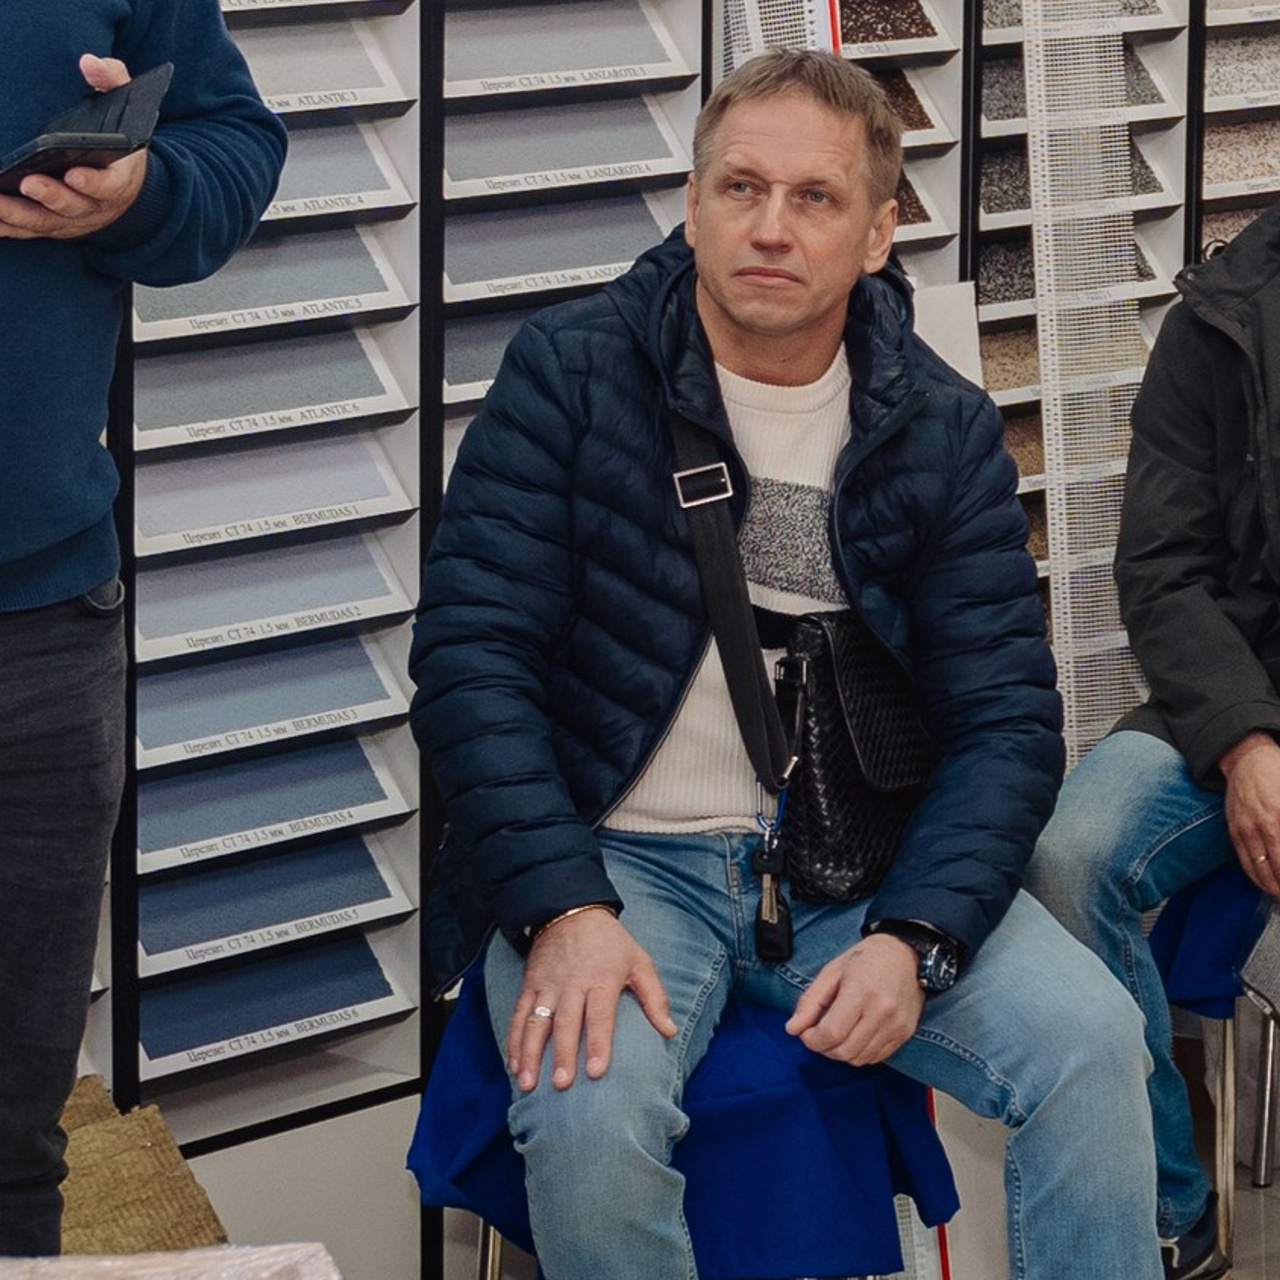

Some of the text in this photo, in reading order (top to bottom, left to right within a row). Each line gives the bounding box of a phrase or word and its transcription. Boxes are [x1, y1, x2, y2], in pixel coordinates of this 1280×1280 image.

[581, 68, 639, 82] LANZAROTE
[297, 94, 349, 107] ATLANTIC
[349, 91, 358, 102] 3
[585, 166, 644, 179] LANZAROTE
[304, 197, 355, 211] ATLANTIC
[355, 195, 365, 205] 4
[265, 308, 279, 319] 1.5
[303, 301, 354, 315] ATLANTIC
[354, 298, 363, 308] 5
[264, 414, 277, 425] 1.5
[300, 405, 352, 420] ATLANTIC
[352, 402, 360, 413] 6
[258, 520, 272, 531] 1.5
[292, 508, 350, 525] BERMUDAS
[351, 505, 359, 515] 1
[260, 622, 274, 634] 1.5
[294, 609, 353, 627] BERMUDAS
[353, 606, 362, 617] 2
[258, 727, 272, 739] 1.5
[293, 712, 350, 731] BERMUDAS
[351, 709, 359, 720] 3
[253, 829, 268, 842] 1.5
[289, 813, 346, 833] BERMUDAS
[346, 810, 355, 821] 4
[259, 930, 273, 942] 1.5
[294, 912, 352, 934] BERMUDAS
[351, 909, 359, 920] 5
[260, 1031, 274, 1043] 1.5
[294, 1012, 352, 1034] BERMUDAS
[352, 1007, 360, 1019] 6
